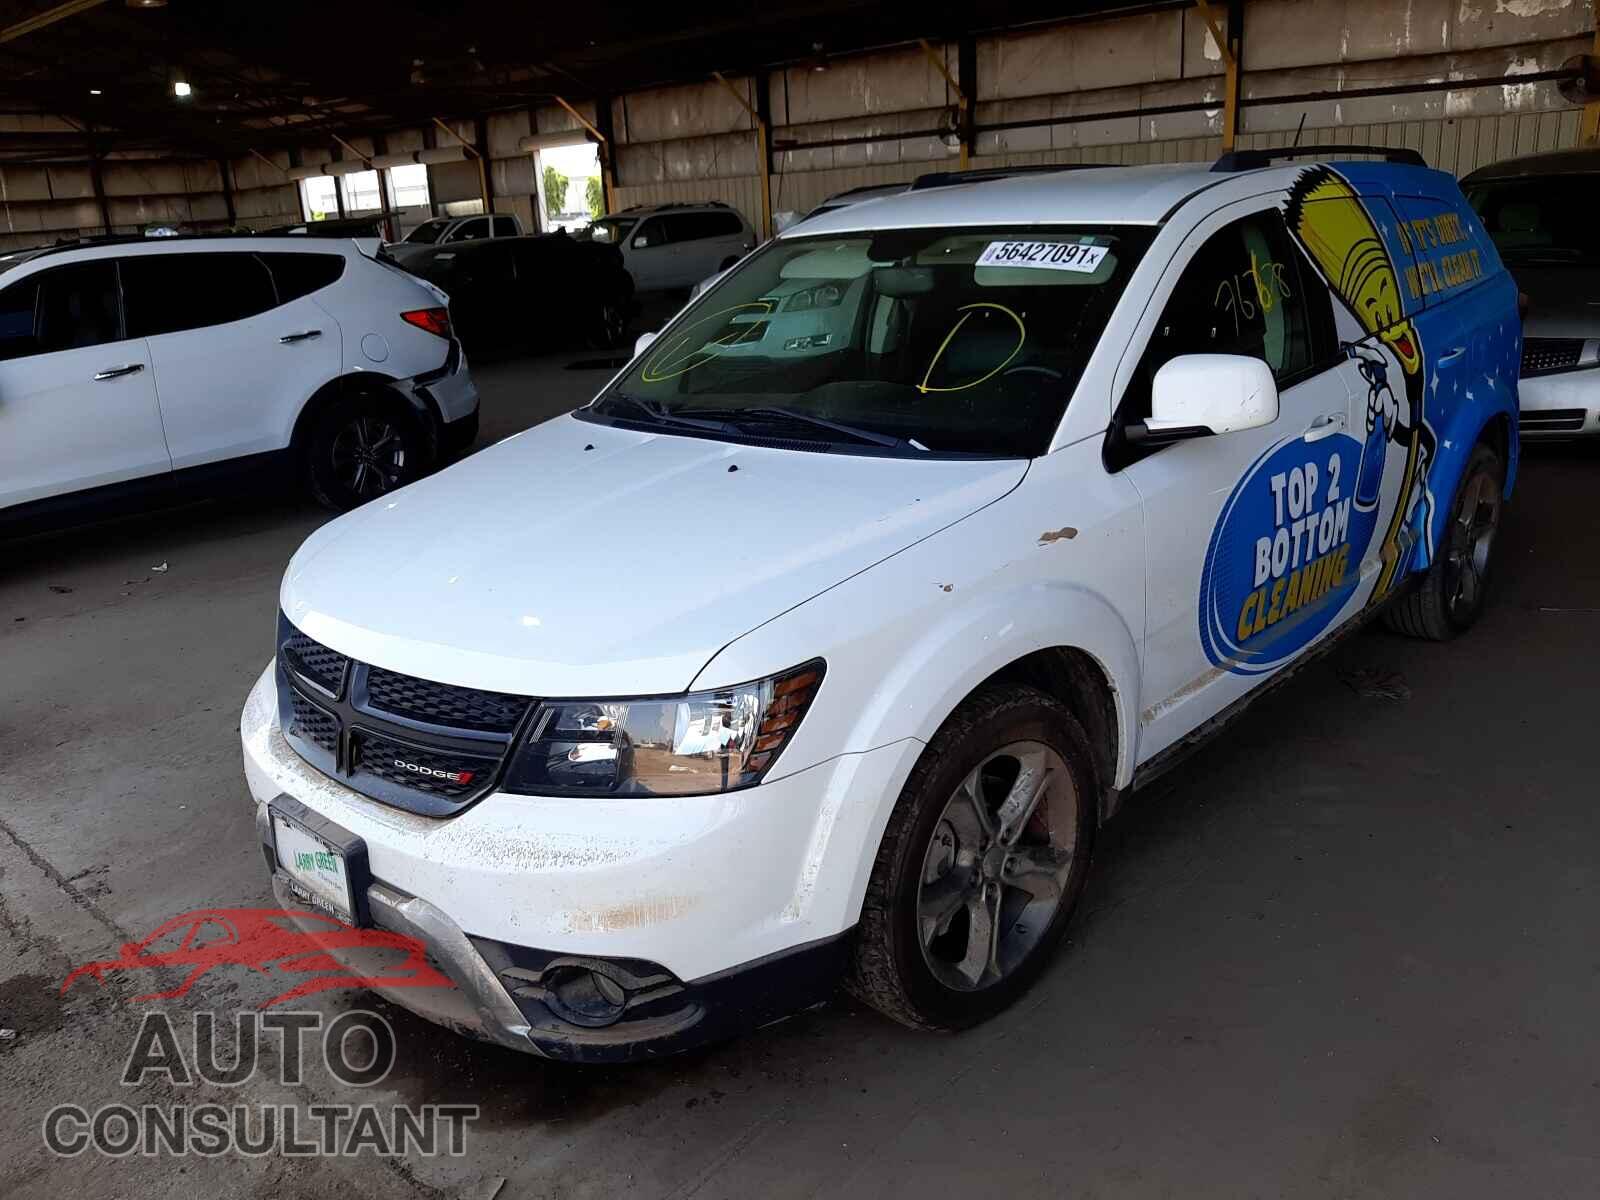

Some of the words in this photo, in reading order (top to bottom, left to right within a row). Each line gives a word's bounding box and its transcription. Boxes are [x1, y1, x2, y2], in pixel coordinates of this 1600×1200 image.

[1271, 462, 1319, 527] TOP
[1327, 453, 1341, 502] 2
[1254, 496, 1351, 588] BOTTOM
[1237, 543, 1350, 641] CLEANING
[394, 759, 461, 781] DODGE
[315, 851, 338, 873] GREEN
